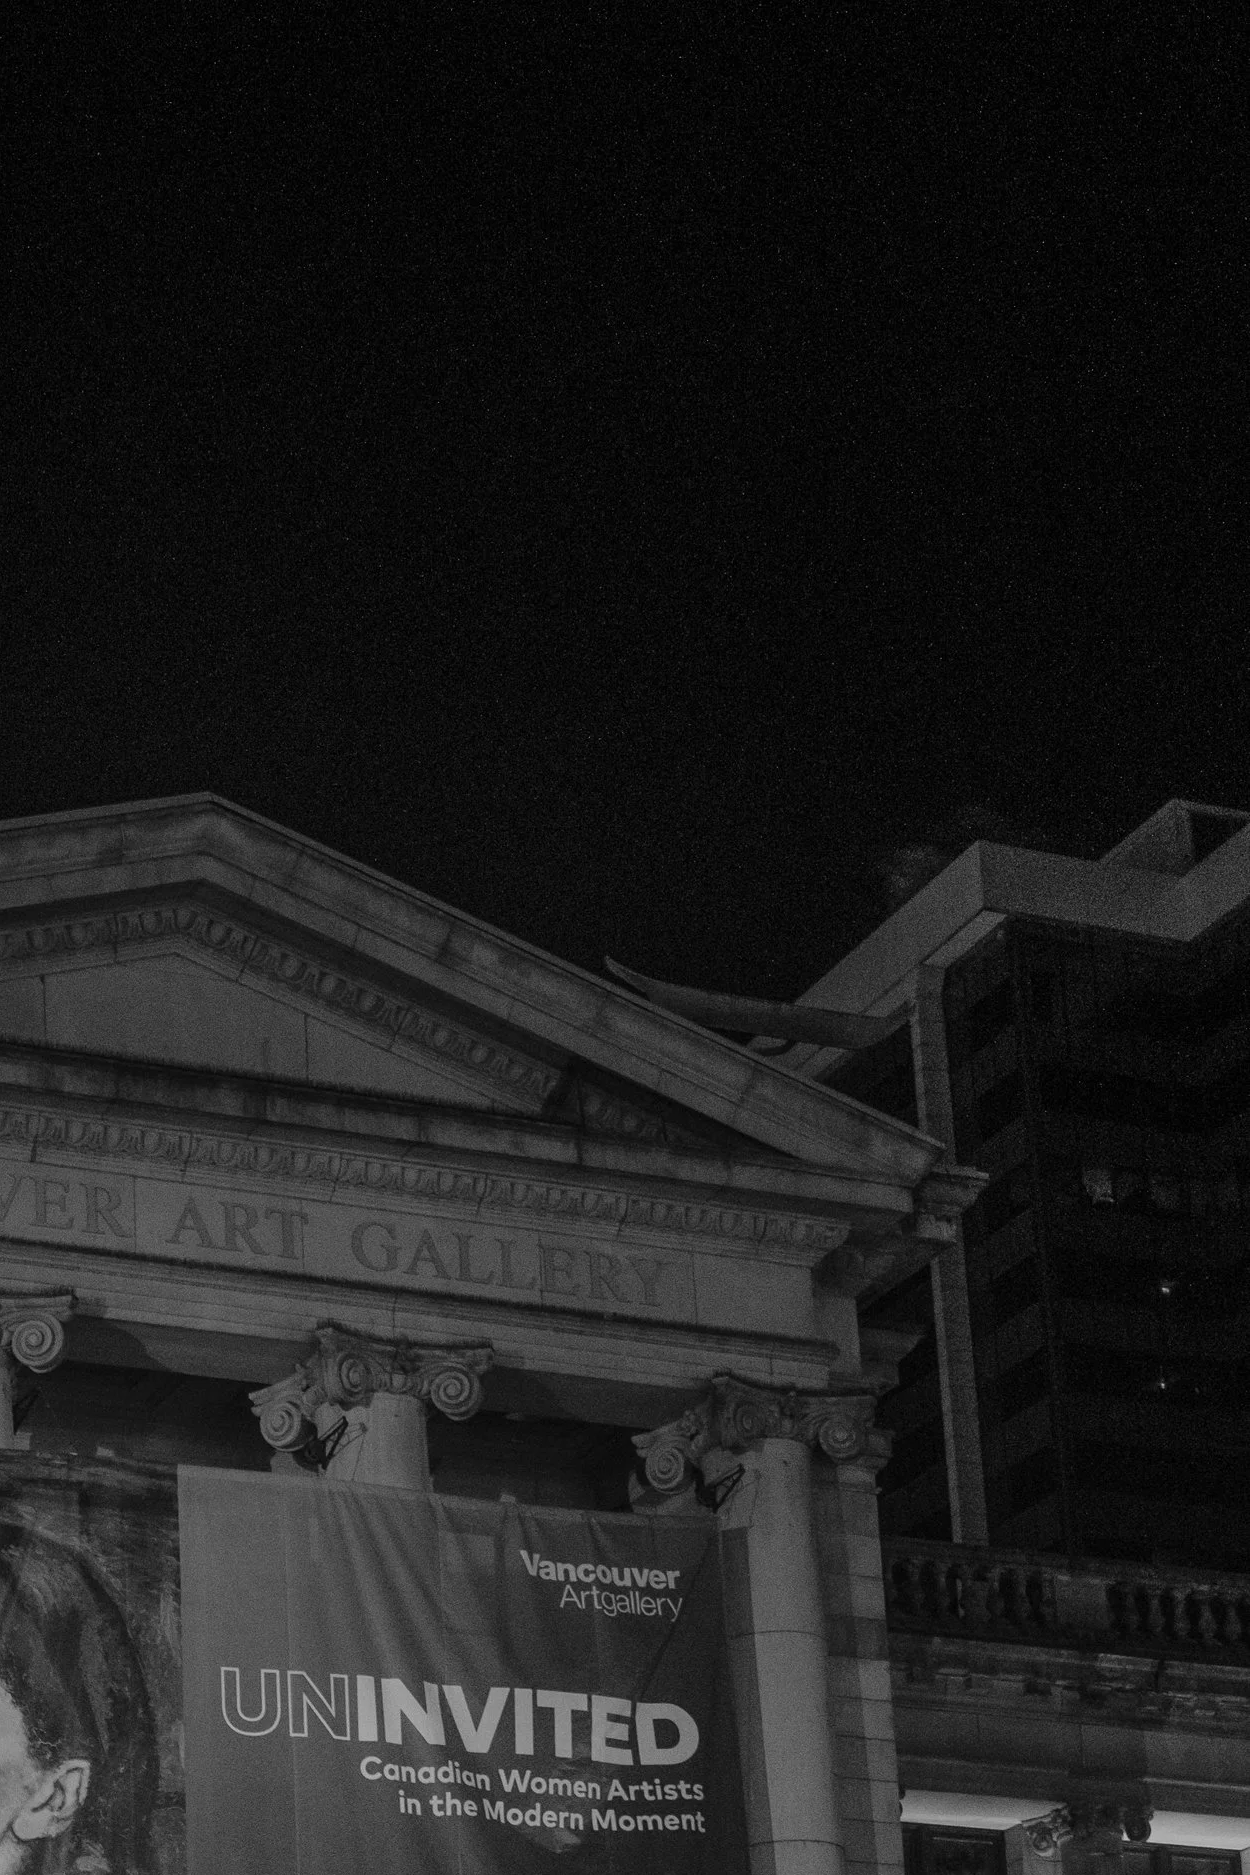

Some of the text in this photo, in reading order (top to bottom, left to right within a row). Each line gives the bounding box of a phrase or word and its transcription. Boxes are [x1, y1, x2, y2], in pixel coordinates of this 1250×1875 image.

[165, 1197, 309, 1260] ART
[350, 1218, 682, 1307] GALLERY
[519, 1549, 681, 1590] Vancouver
[559, 1585, 683, 1622] Artgallery
[220, 1666, 700, 1767] UNINVITED
[359, 1755, 704, 1801] Canadian Women Artists
[398, 1789, 706, 1833] in the Modern Moment
